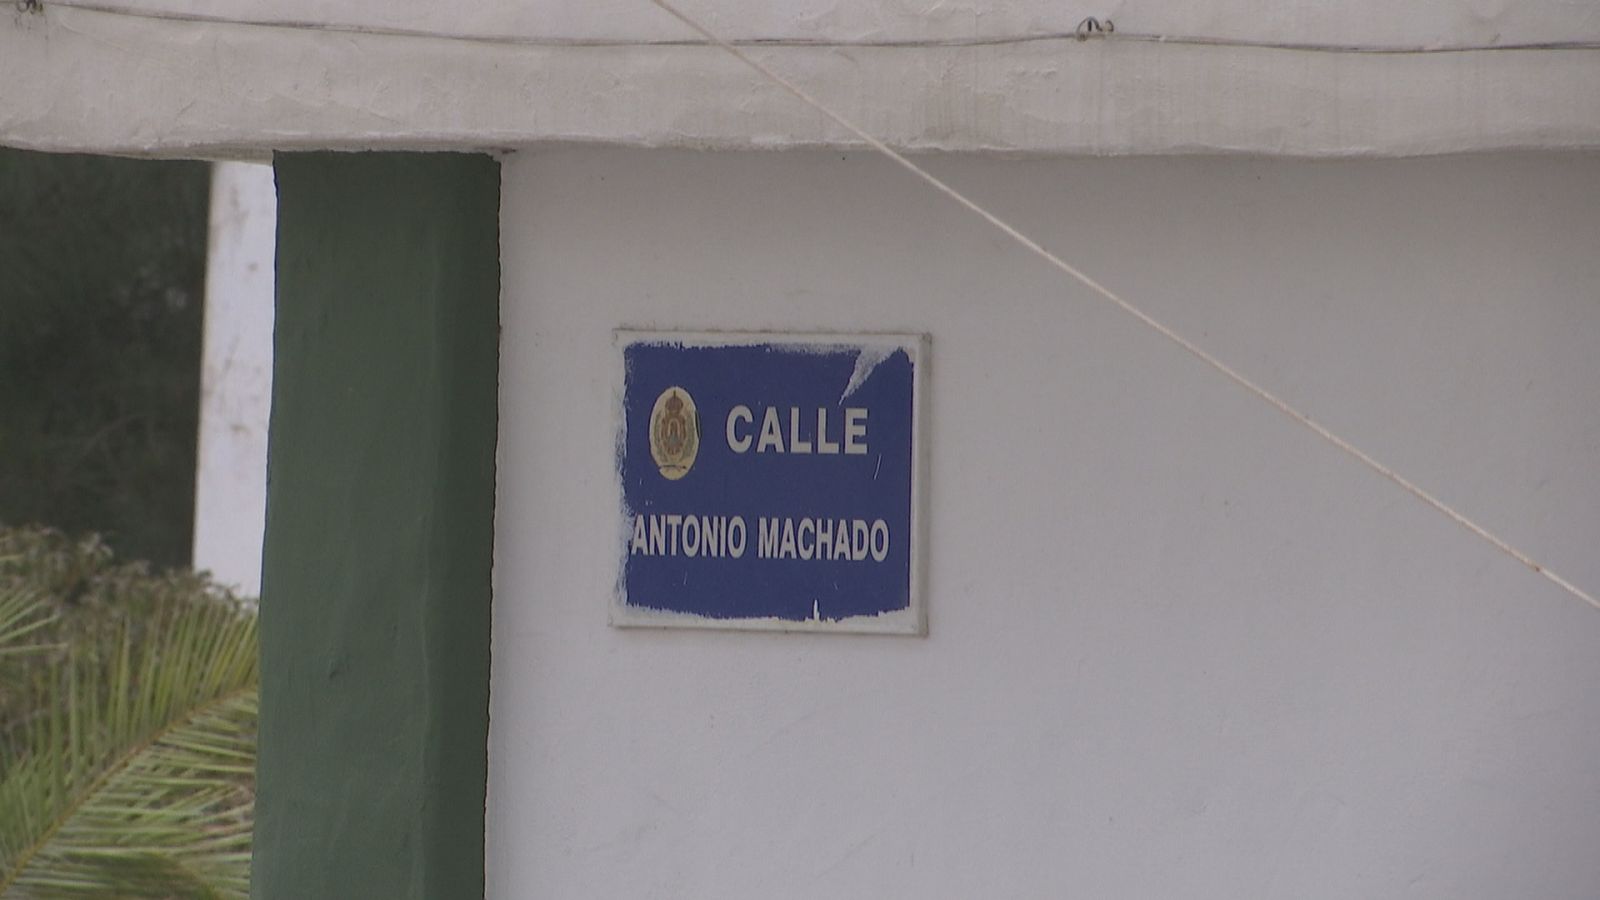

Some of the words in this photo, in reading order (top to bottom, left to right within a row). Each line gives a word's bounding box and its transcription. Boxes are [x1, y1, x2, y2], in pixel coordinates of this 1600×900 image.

[726, 404, 868, 454] CALLE
[631, 514, 746, 559] ANTONIO
[757, 516, 889, 562] MACHADO
